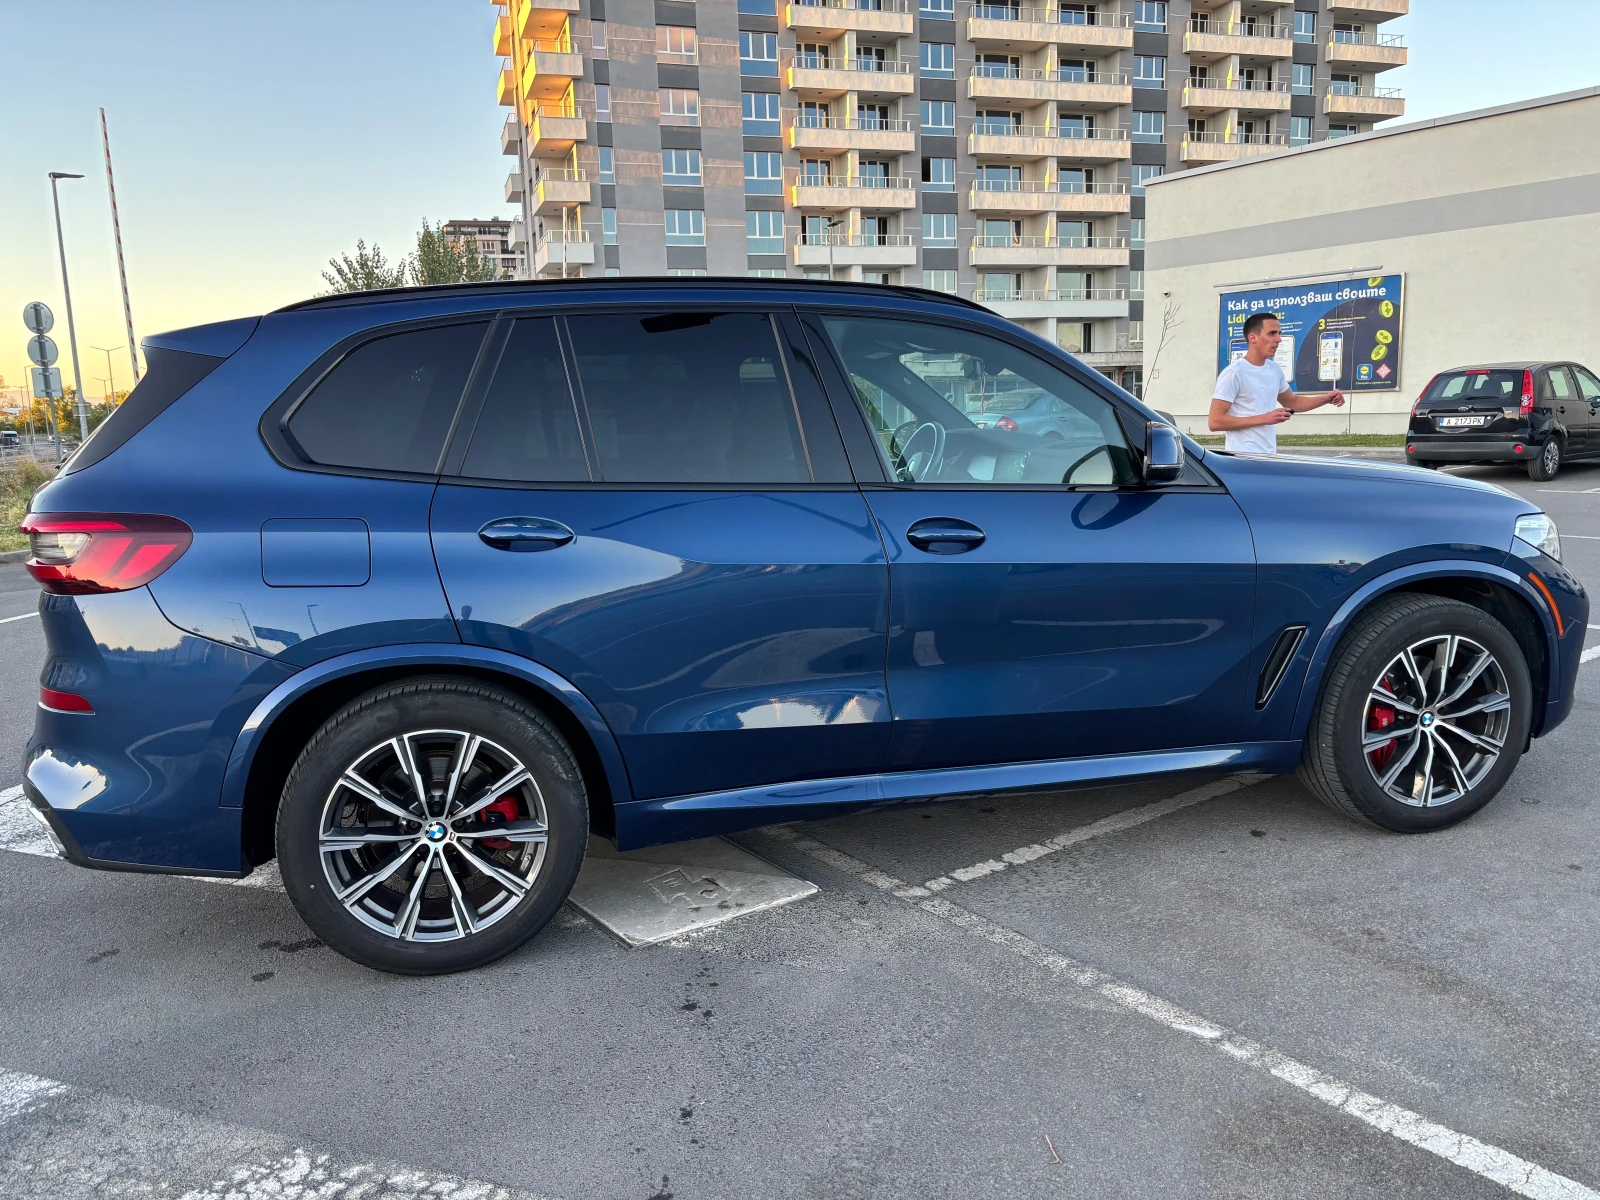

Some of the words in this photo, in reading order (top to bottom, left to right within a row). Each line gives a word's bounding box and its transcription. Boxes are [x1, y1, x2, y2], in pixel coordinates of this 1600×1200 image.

[1228, 299, 1248, 311] Как
[1250, 300, 1264, 311] да
[1266, 291, 1333, 309] използваш
[1335, 287, 1387, 300] своите
[1228, 313, 1246, 324] Lidl
[1318, 318, 1326, 330] 3
[1227, 326, 1233, 337] 1
